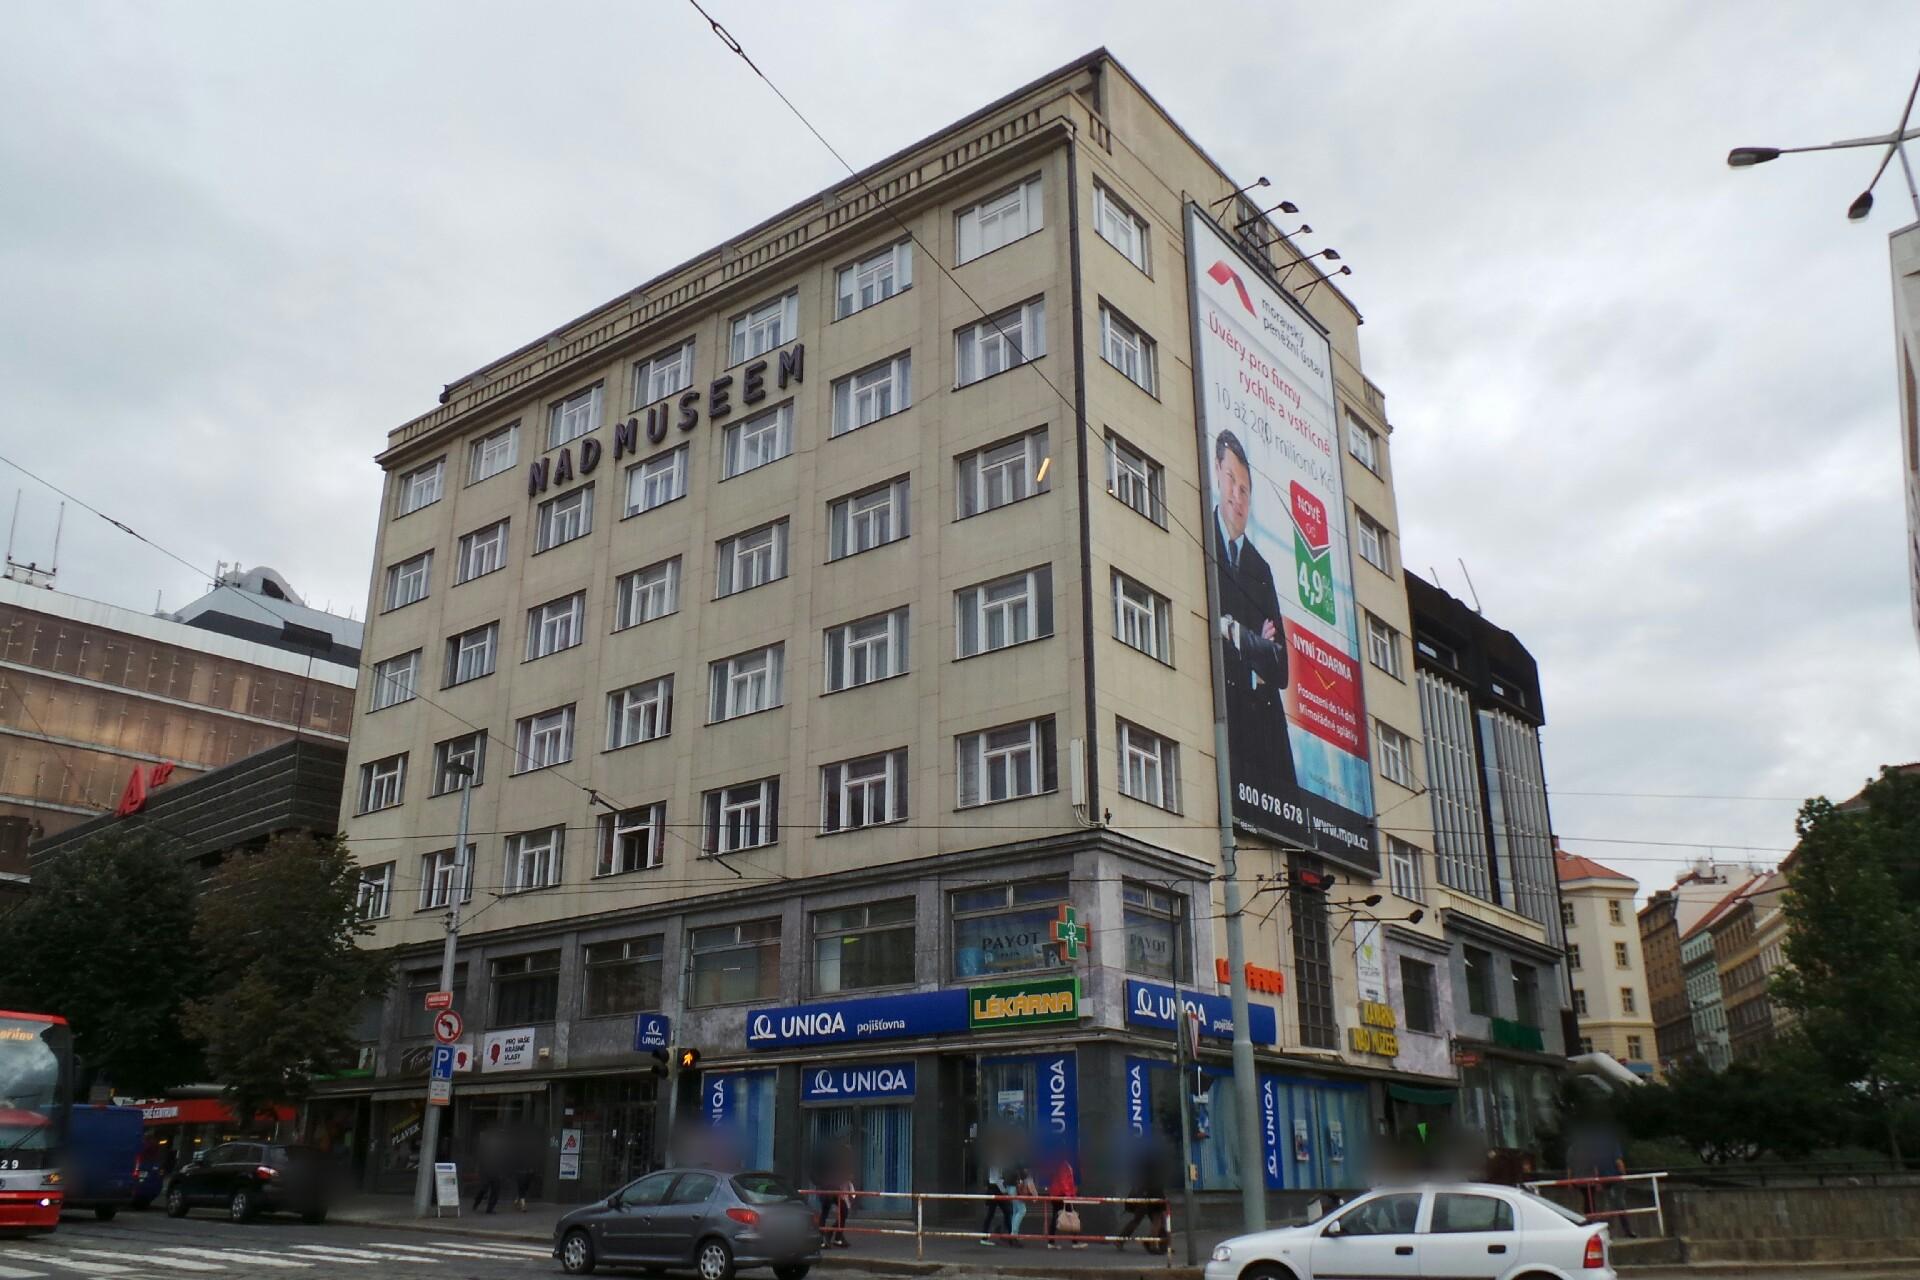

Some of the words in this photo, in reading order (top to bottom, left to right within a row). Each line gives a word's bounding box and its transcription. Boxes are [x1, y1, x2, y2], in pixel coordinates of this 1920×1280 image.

[1215, 382, 1230, 410] 10
[1234, 401, 1247, 424] až
[1240, 370, 1275, 411] rychle
[1278, 403, 1285, 418] a
[1249, 352, 1269, 378] pro
[1271, 367, 1301, 409] firmy
[528, 437, 601, 497] NAD
[614, 344, 804, 460] MUSEEM
[1293, 633, 1316, 659] NYNÍ
[1316, 647, 1352, 681] ZDARMA
[1239, 783, 1259, 806] 800
[1261, 793, 1281, 816] 678
[1283, 803, 1303, 824] 678
[1312, 817, 1369, 850] www.mpu.cz
[982, 932, 1040, 951] PAYOT
[781, 1012, 846, 1038] UNIQA
[857, 1018, 905, 1035] pojišťovna
[974, 991, 1073, 1020] LÉKÁRNA
[437, 1049, 450, 1069] P
[642, 1036, 665, 1046] UNIQA
[843, 1069, 907, 1093] UNIQA
[1050, 1059, 1066, 1134] UNIQA
[1264, 1080, 1276, 1145] UNIQA
